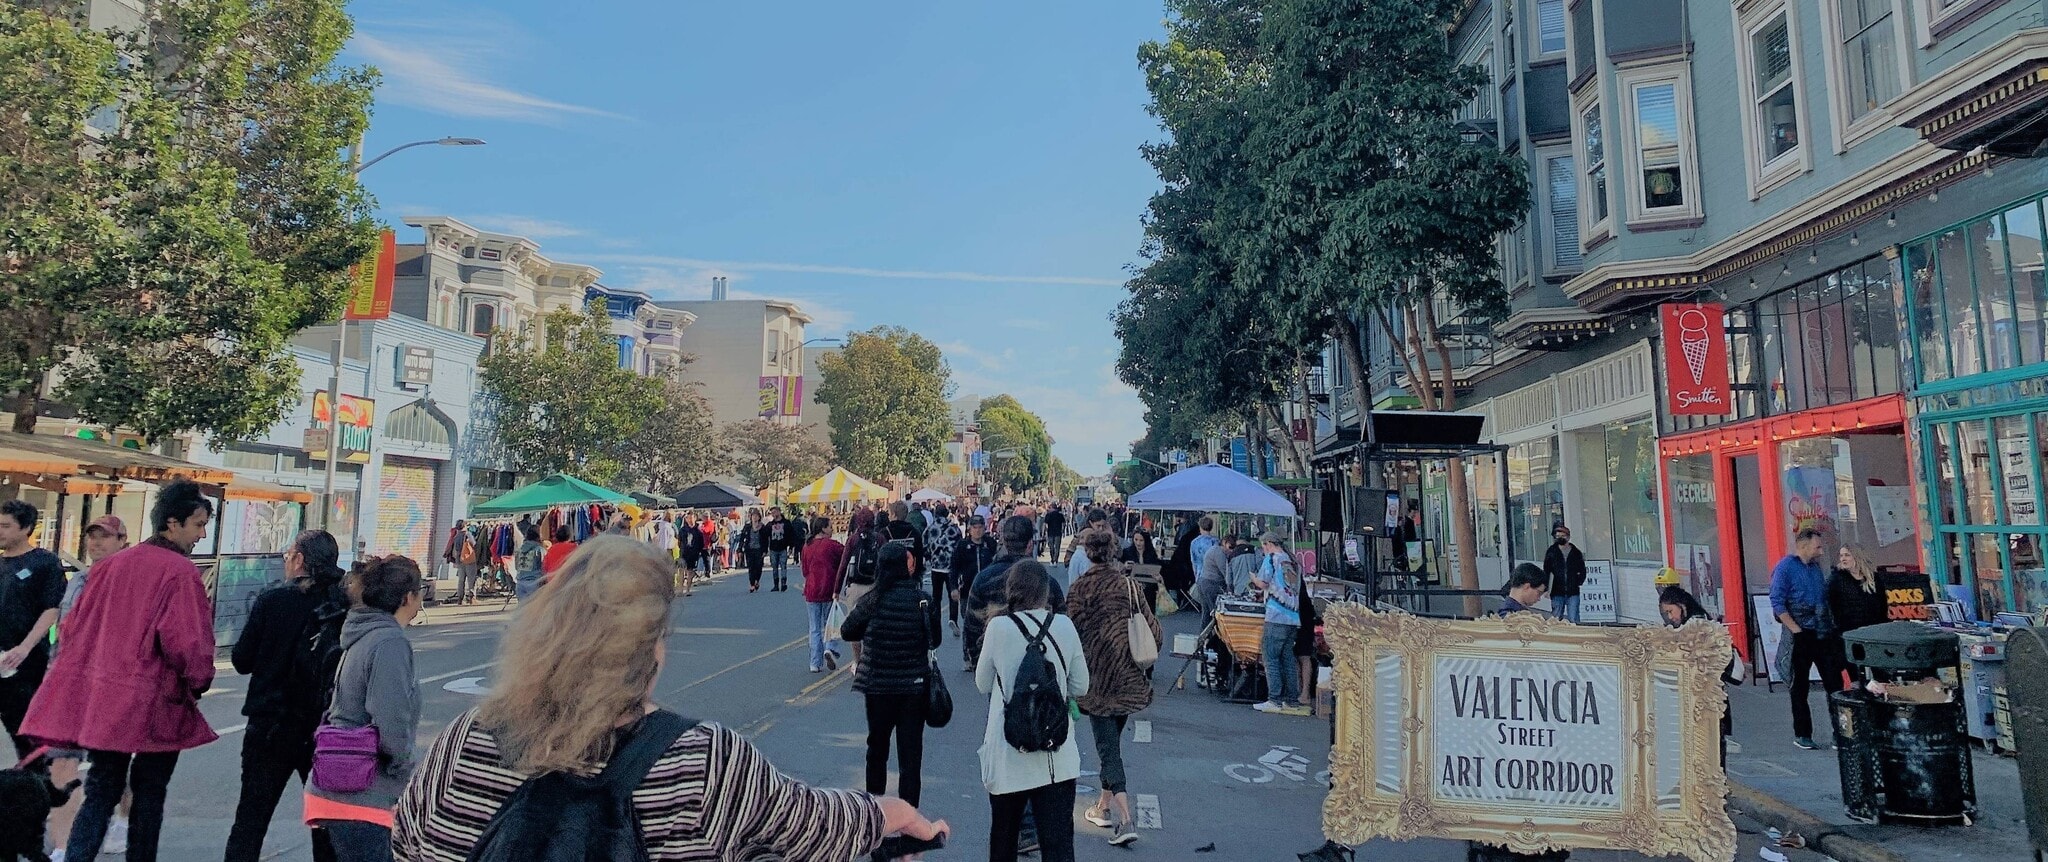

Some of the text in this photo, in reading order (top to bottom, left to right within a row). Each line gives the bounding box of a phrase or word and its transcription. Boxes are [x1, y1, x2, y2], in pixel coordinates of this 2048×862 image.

[1677, 387, 1722, 408] Smitten
[1585, 565, 1602, 574] OURE
[1583, 592, 1608, 601] LUCKY
[1885, 588, 1924, 604] OOKS
[1584, 604, 1613, 612] CHARM
[1450, 674, 1600, 725] VALENCIA
[1498, 723, 1556, 748] STREET
[1442, 755, 1614, 795] ART CORRIDOR
